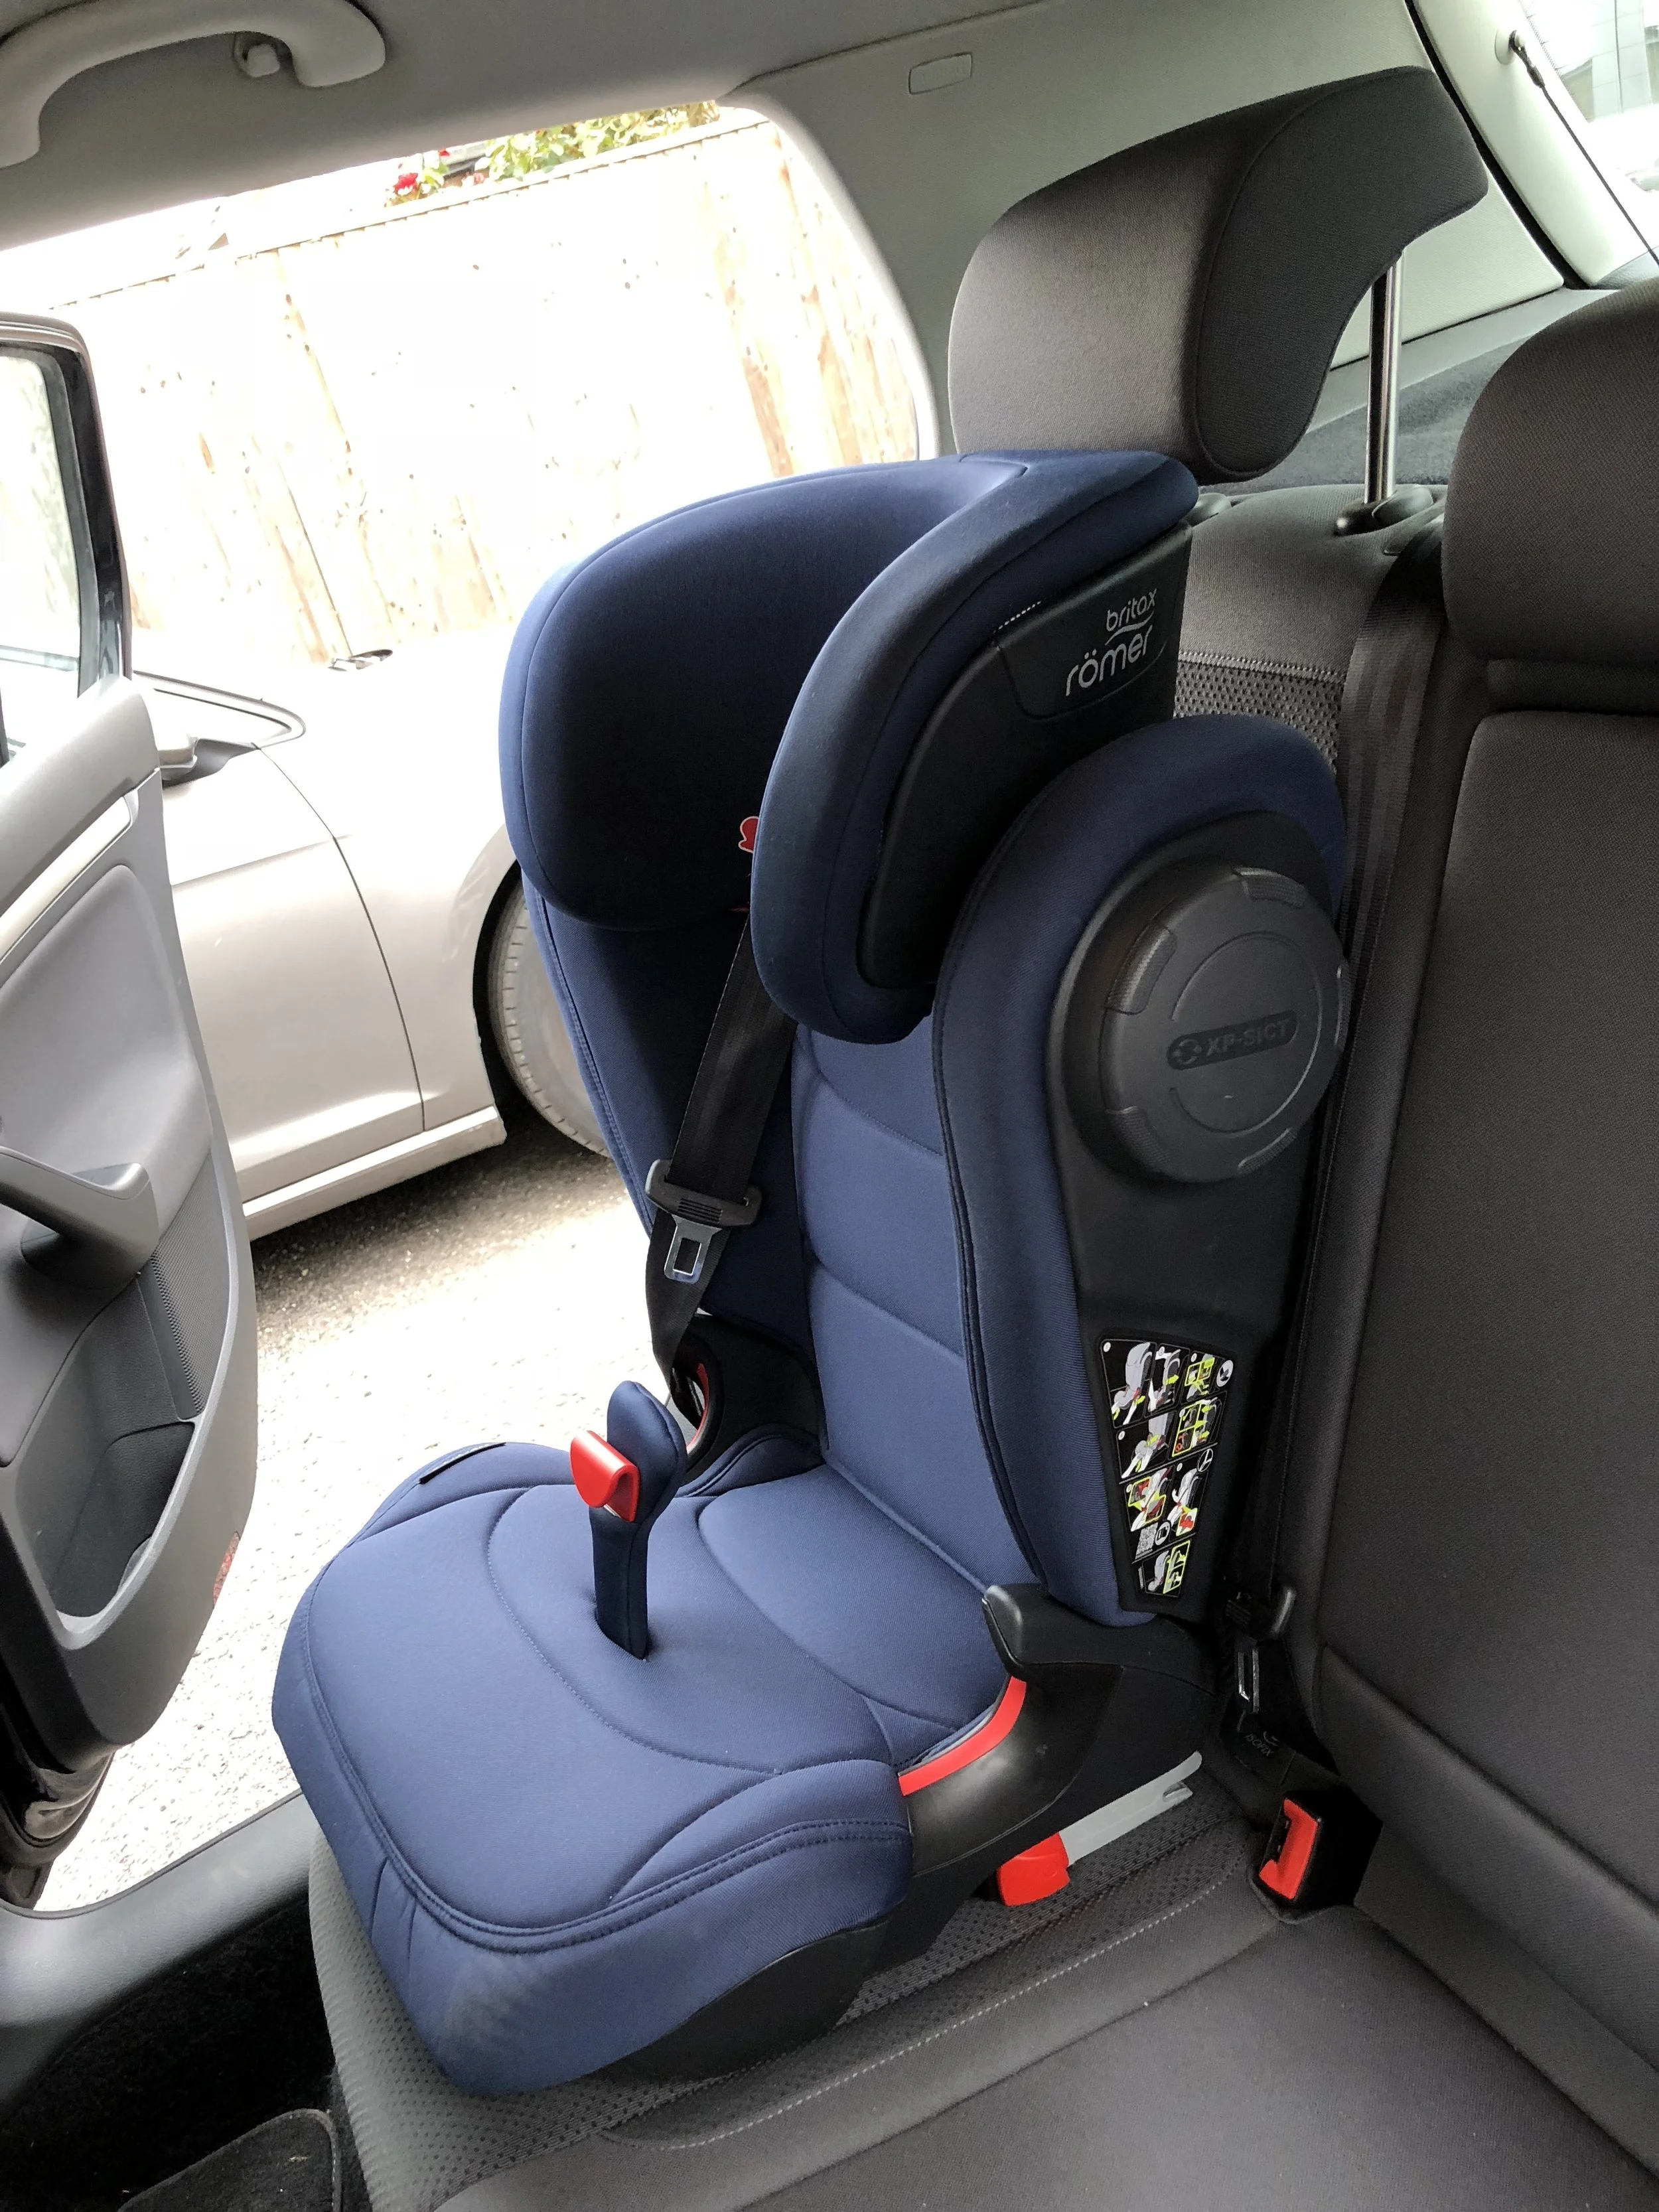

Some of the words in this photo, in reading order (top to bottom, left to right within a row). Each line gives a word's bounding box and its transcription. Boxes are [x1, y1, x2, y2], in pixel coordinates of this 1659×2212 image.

[1106, 588, 1157, 631] britax
[1065, 625, 1153, 696] römer
[1206, 1019, 1290, 1057] XP-SICT
